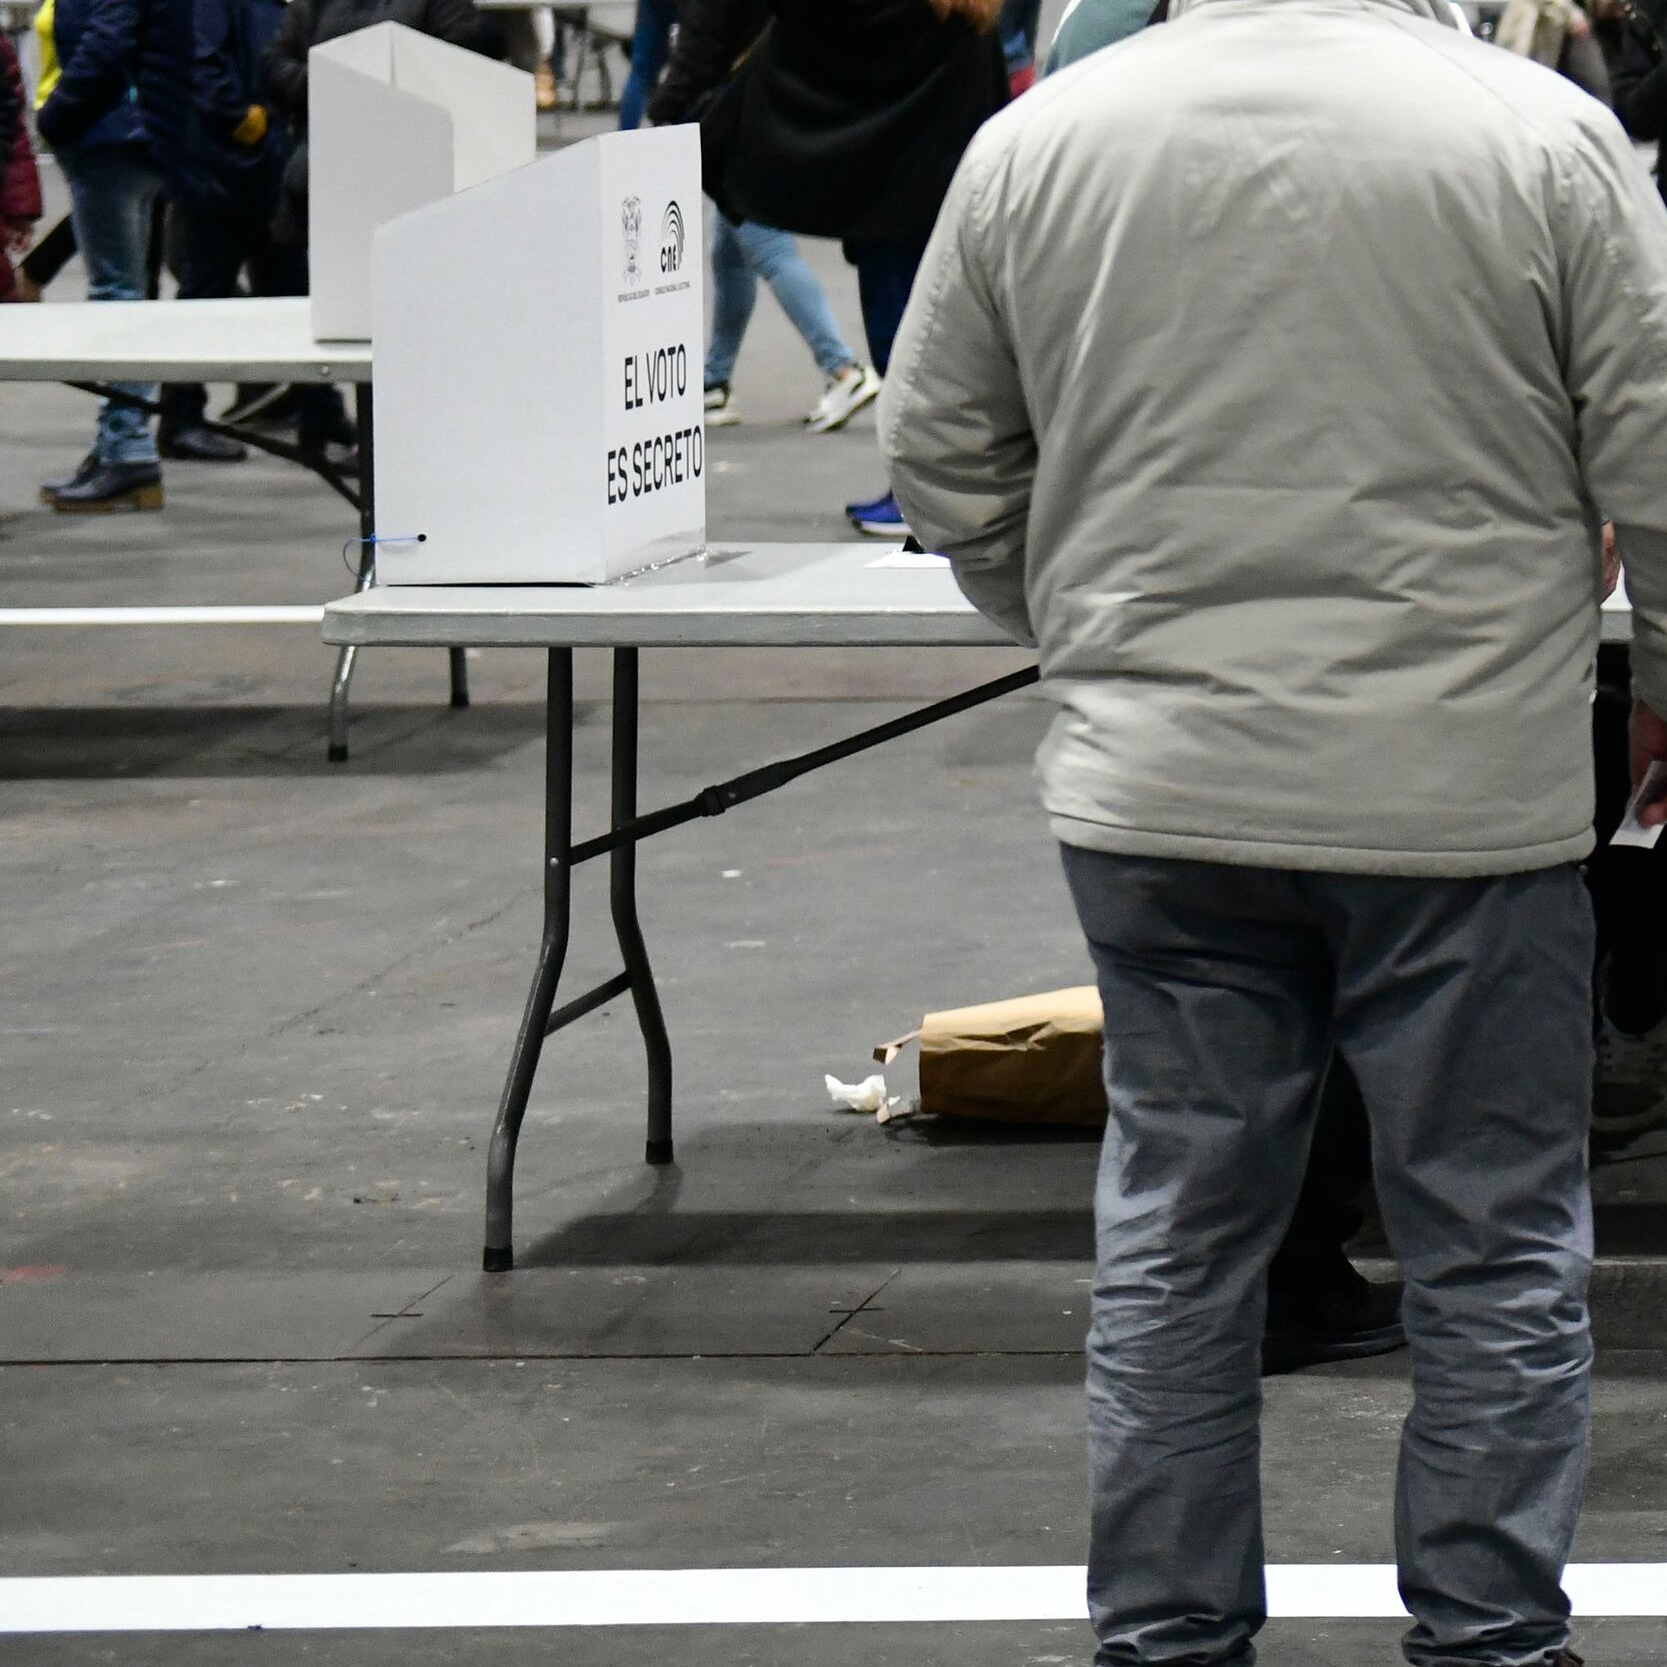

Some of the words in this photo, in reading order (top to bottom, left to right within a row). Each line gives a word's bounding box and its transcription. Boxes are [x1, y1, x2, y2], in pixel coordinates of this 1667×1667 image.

[624, 356, 643, 410] EL
[646, 343, 687, 405] VOTO
[607, 446, 628, 505] ES
[632, 425, 702, 498] SECRETO
